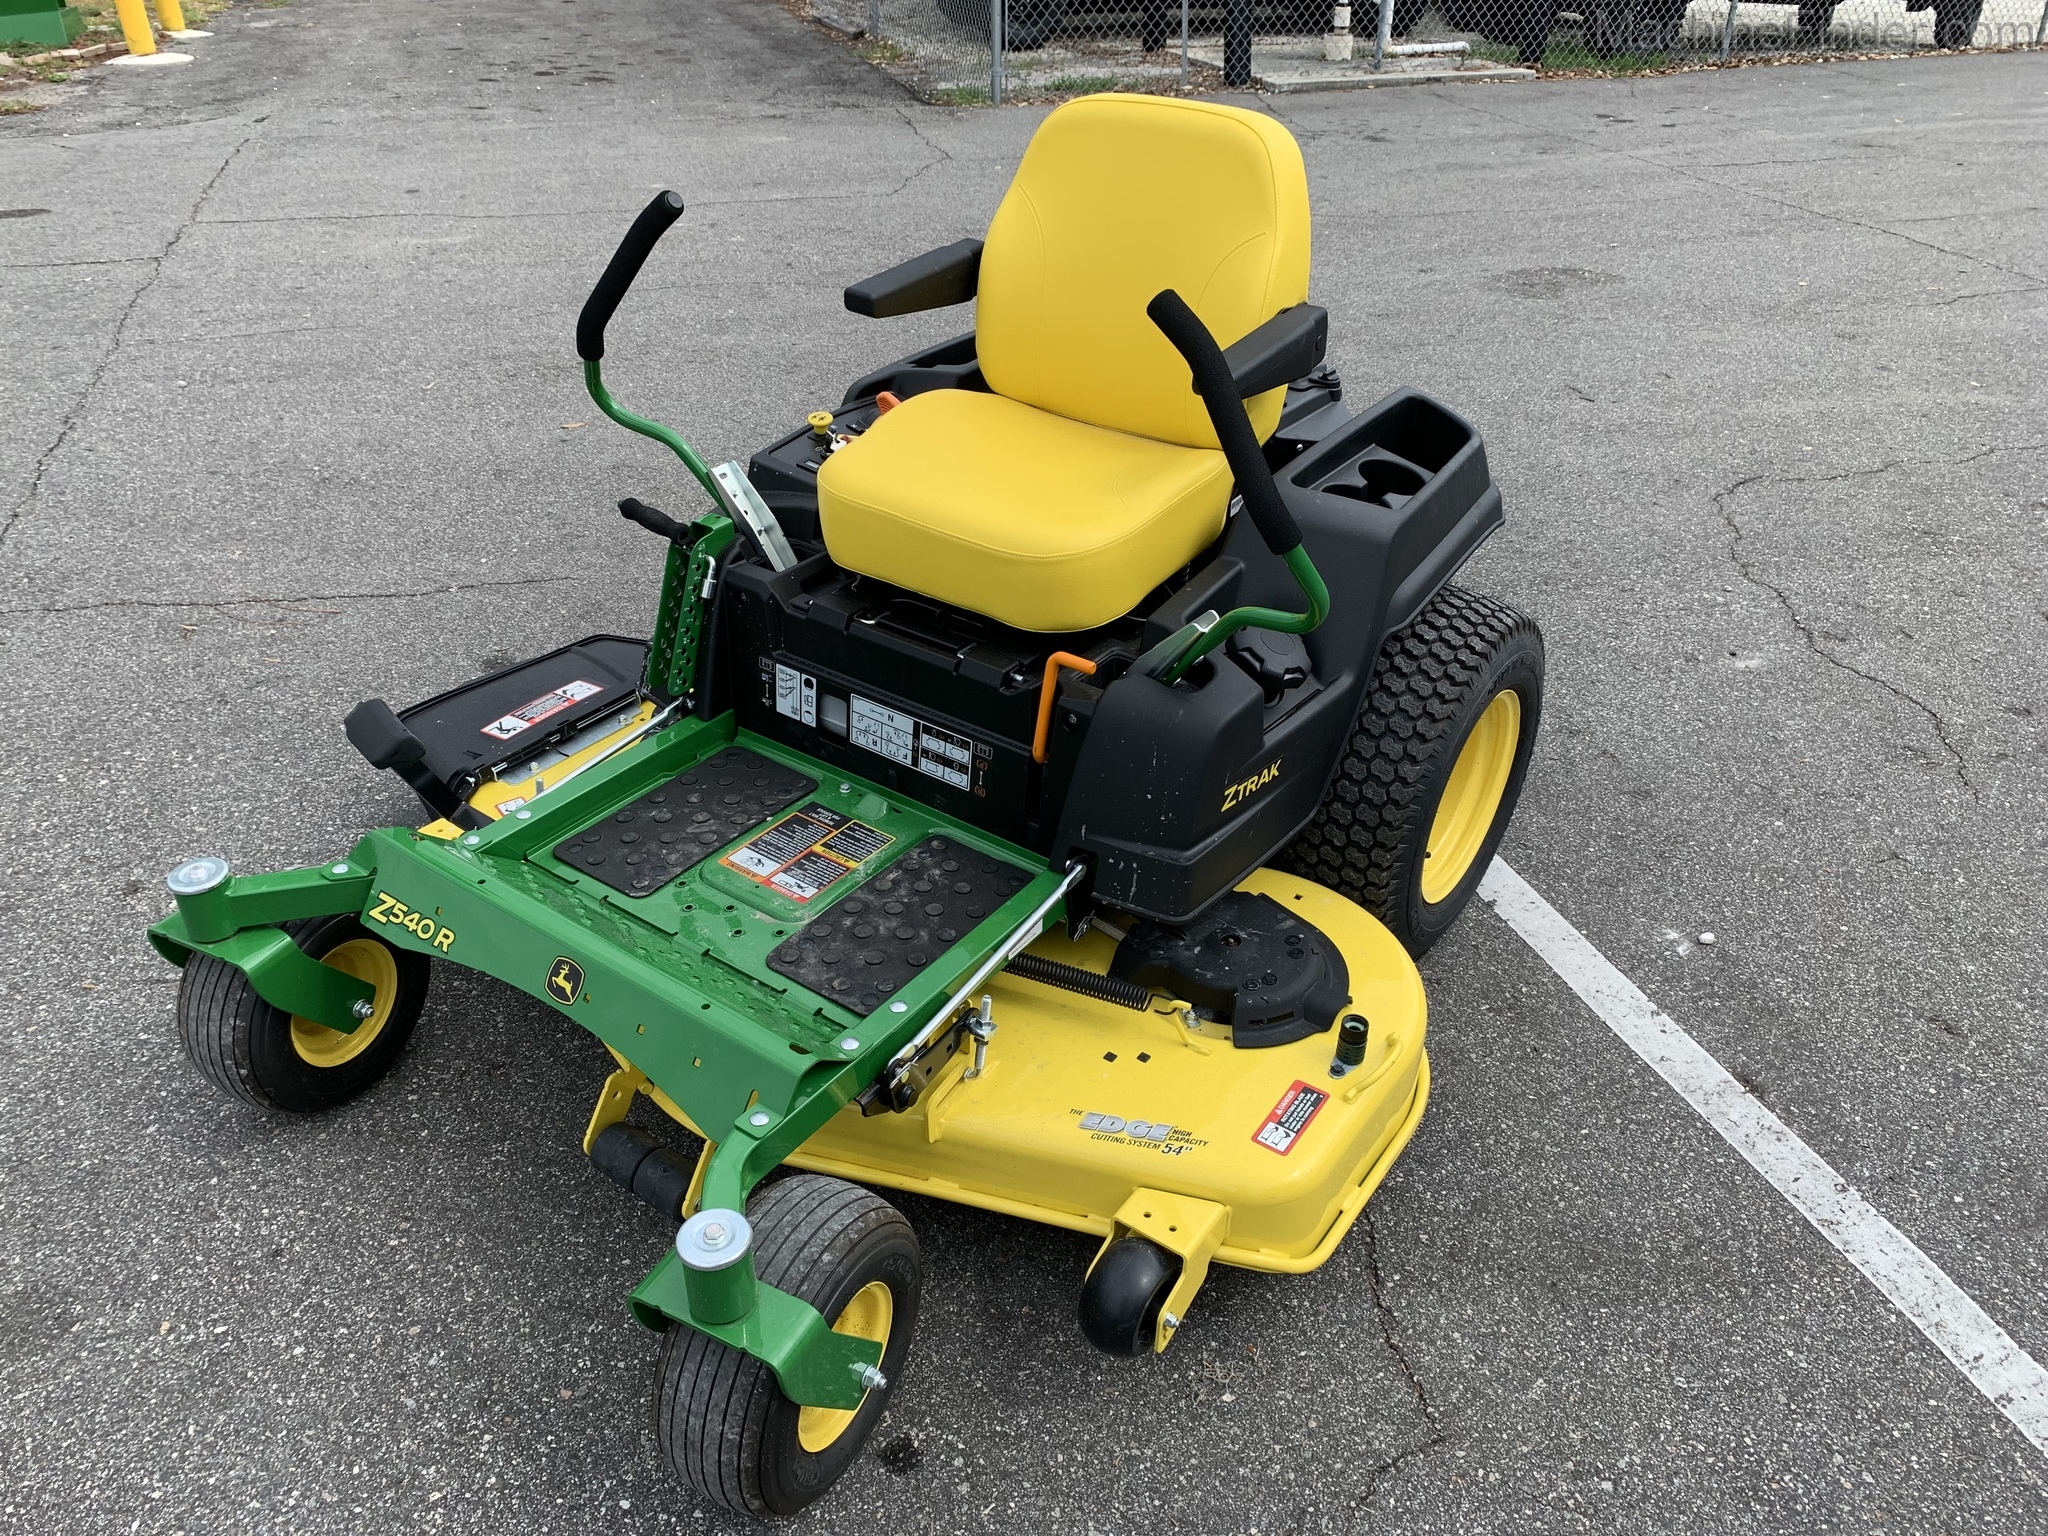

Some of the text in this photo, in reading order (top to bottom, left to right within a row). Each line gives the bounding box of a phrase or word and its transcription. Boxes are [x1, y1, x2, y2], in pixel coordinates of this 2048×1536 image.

[1220, 759, 1282, 813] ZTRAK
[367, 890, 456, 954] Z540 R
[1279, 1090, 1296, 1110] DANGER
[1069, 1108, 1085, 1116] THE
[1077, 1111, 1174, 1142] EDGE
[1171, 1129, 1193, 1138] HIGH
[1090, 1132, 1161, 1150] CUTTING SYSTEM
[1161, 1142, 1193, 1156] 54"
[1167, 1135, 1210, 1147] CAPACITY
